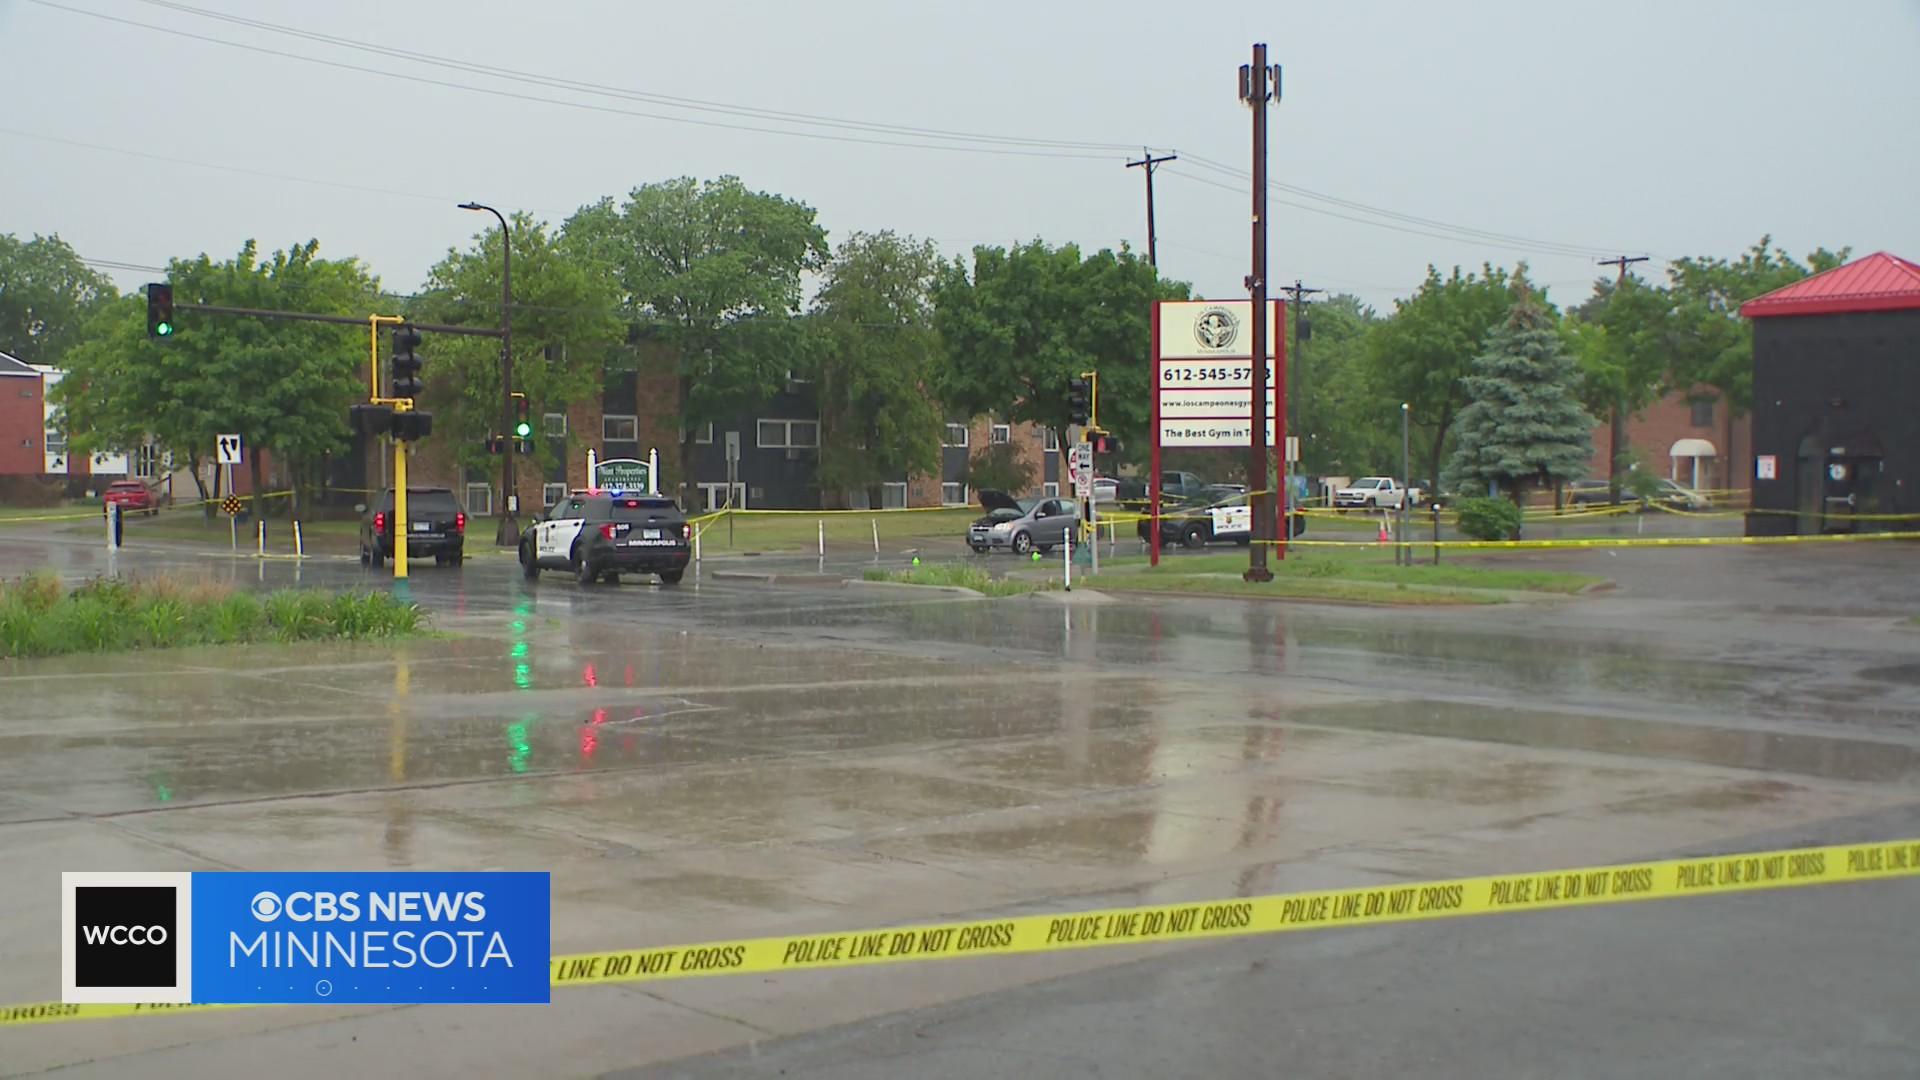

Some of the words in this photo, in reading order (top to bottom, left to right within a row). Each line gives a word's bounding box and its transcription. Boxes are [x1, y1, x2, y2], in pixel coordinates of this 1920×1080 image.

[1164, 368, 1271, 381] 612-545-573
[1165, 429, 1182, 437] The
[1185, 429, 1206, 437] Best
[1208, 428, 1231, 439] Gym
[1233, 428, 1242, 437] in
[1244, 428, 1270, 437] Tn
[1488, 878, 1533, 905] POLICE
[1535, 875, 1562, 901] LINE
[1563, 875, 1582, 899] DO
[1583, 871, 1609, 896] NOT
[1611, 868, 1653, 895] CROSS
[1676, 863, 1714, 889] POLICE
[1717, 859, 1743, 885] LINE
[1743, 858, 1760, 882] DO
[1761, 856, 1785, 880] NOT
[1787, 852, 1826, 878] CROSS
[1280, 896, 1330, 924] POLICE
[1331, 893, 1363, 919] LINE
[1364, 891, 1385, 917] DO
[1387, 888, 1417, 914] NOT
[1418, 884, 1464, 912] CROSS
[1046, 916, 1103, 943] POLICE
[1104, 913, 1140, 938] LINE
[1141, 911, 1165, 935] DO
[1166, 907, 1200, 933] NOT
[1201, 903, 1252, 931] CROSS
[783, 937, 847, 964] POLICE
[848, 933, 889, 958] LINE
[888, 932, 916, 956] DO
[916, 928, 957, 953] NOT
[956, 923, 1014, 950] CROSS
[557, 957, 601, 981] LINE
[603, 955, 632, 978] DO
[635, 951, 680, 975] NOT
[680, 945, 747, 972] CROSS
